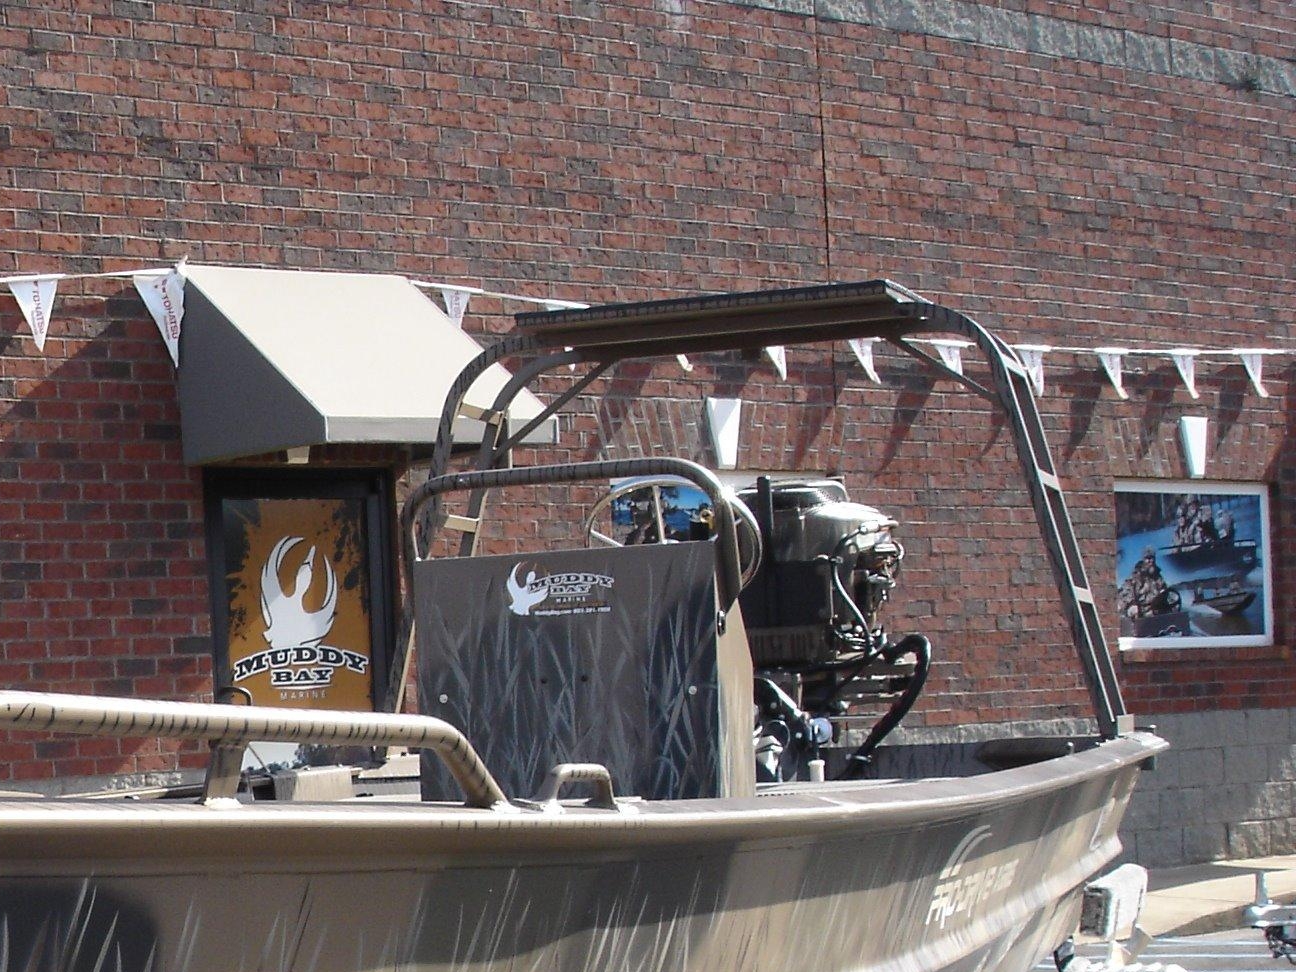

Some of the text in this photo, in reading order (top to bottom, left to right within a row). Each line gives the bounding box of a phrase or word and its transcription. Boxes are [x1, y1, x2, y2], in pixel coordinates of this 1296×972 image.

[528, 573, 614, 593] MUDDY
[550, 584, 591, 594] BAY
[234, 646, 369, 681] MUDDY
[271, 667, 334, 685] BAY
[280, 690, 327, 701] MARINE
